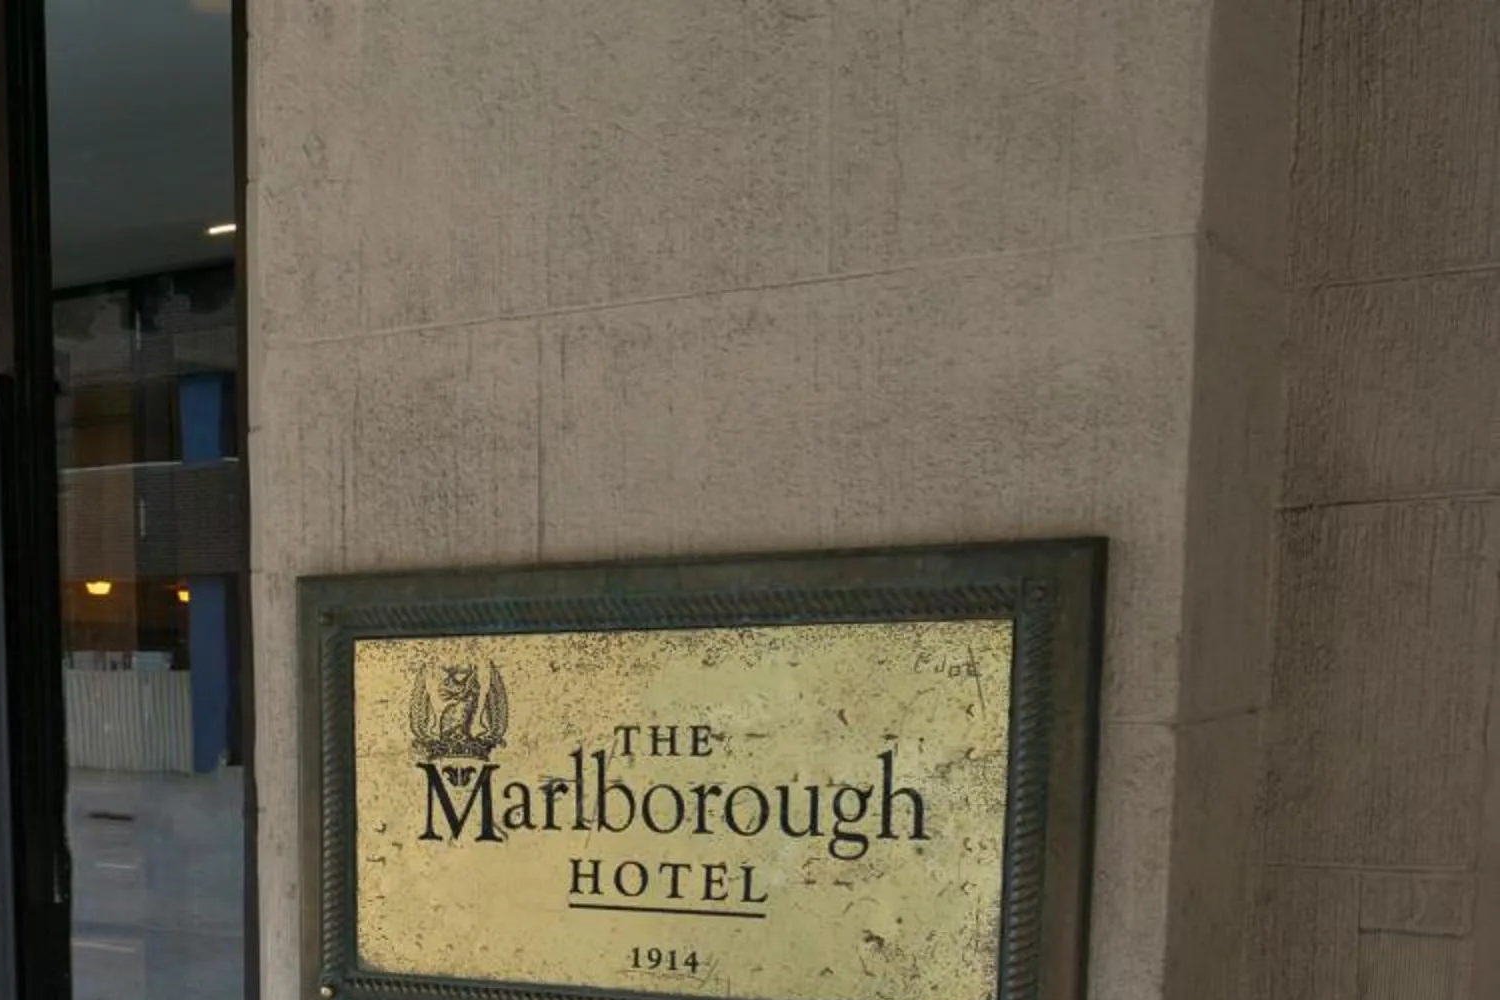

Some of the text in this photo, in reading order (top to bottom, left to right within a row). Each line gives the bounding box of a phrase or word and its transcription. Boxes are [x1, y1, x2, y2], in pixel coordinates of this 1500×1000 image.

[614, 725, 713, 757] THE
[417, 749, 930, 860] Marlborough
[569, 859, 768, 902] HOTEL
[631, 947, 699, 974] 1914
